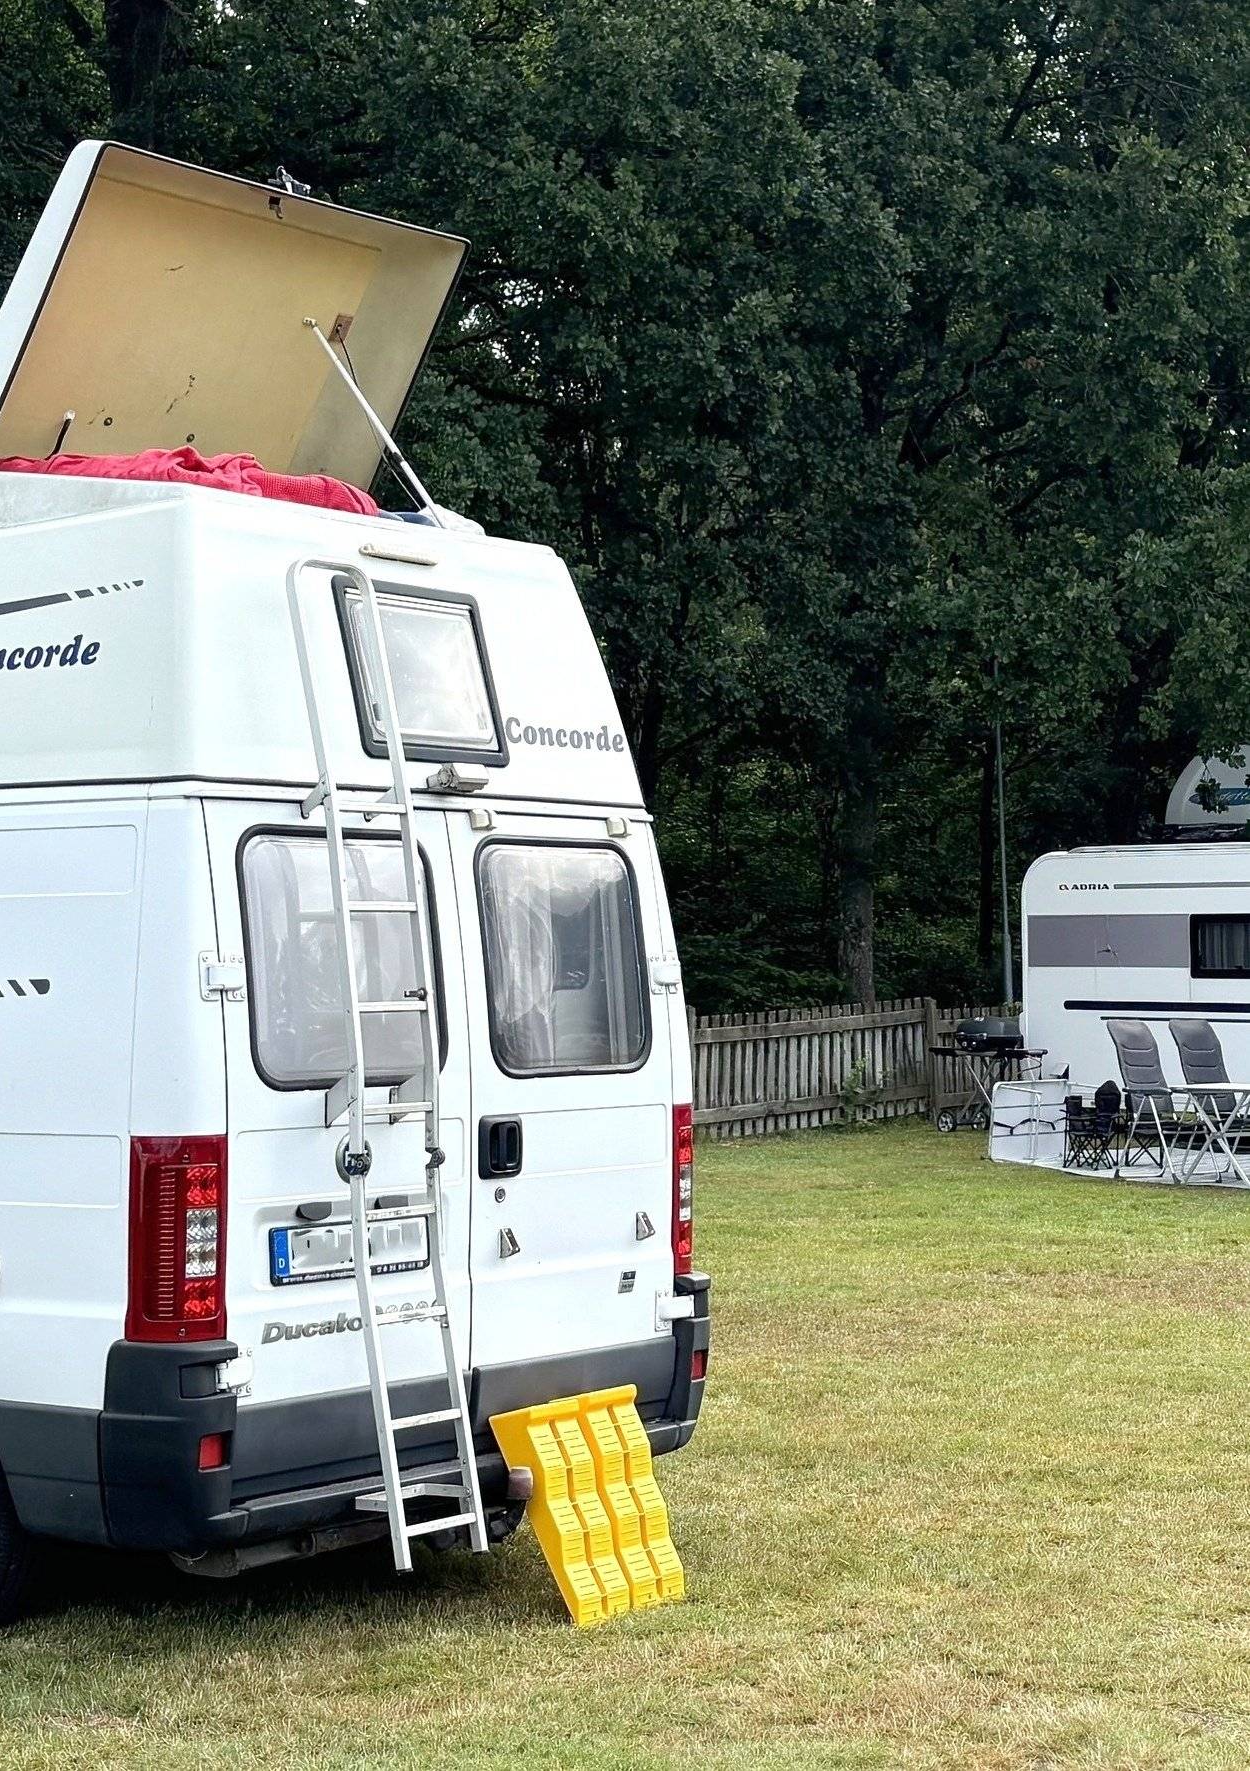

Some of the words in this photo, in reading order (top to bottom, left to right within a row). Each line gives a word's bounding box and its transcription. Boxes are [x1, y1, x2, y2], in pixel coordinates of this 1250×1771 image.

[505, 717, 625, 752] Concorde
[1071, 883, 1110, 891] ADRIA
[279, 1259, 286, 1269] D
[261, 1312, 363, 1344] Ducato
